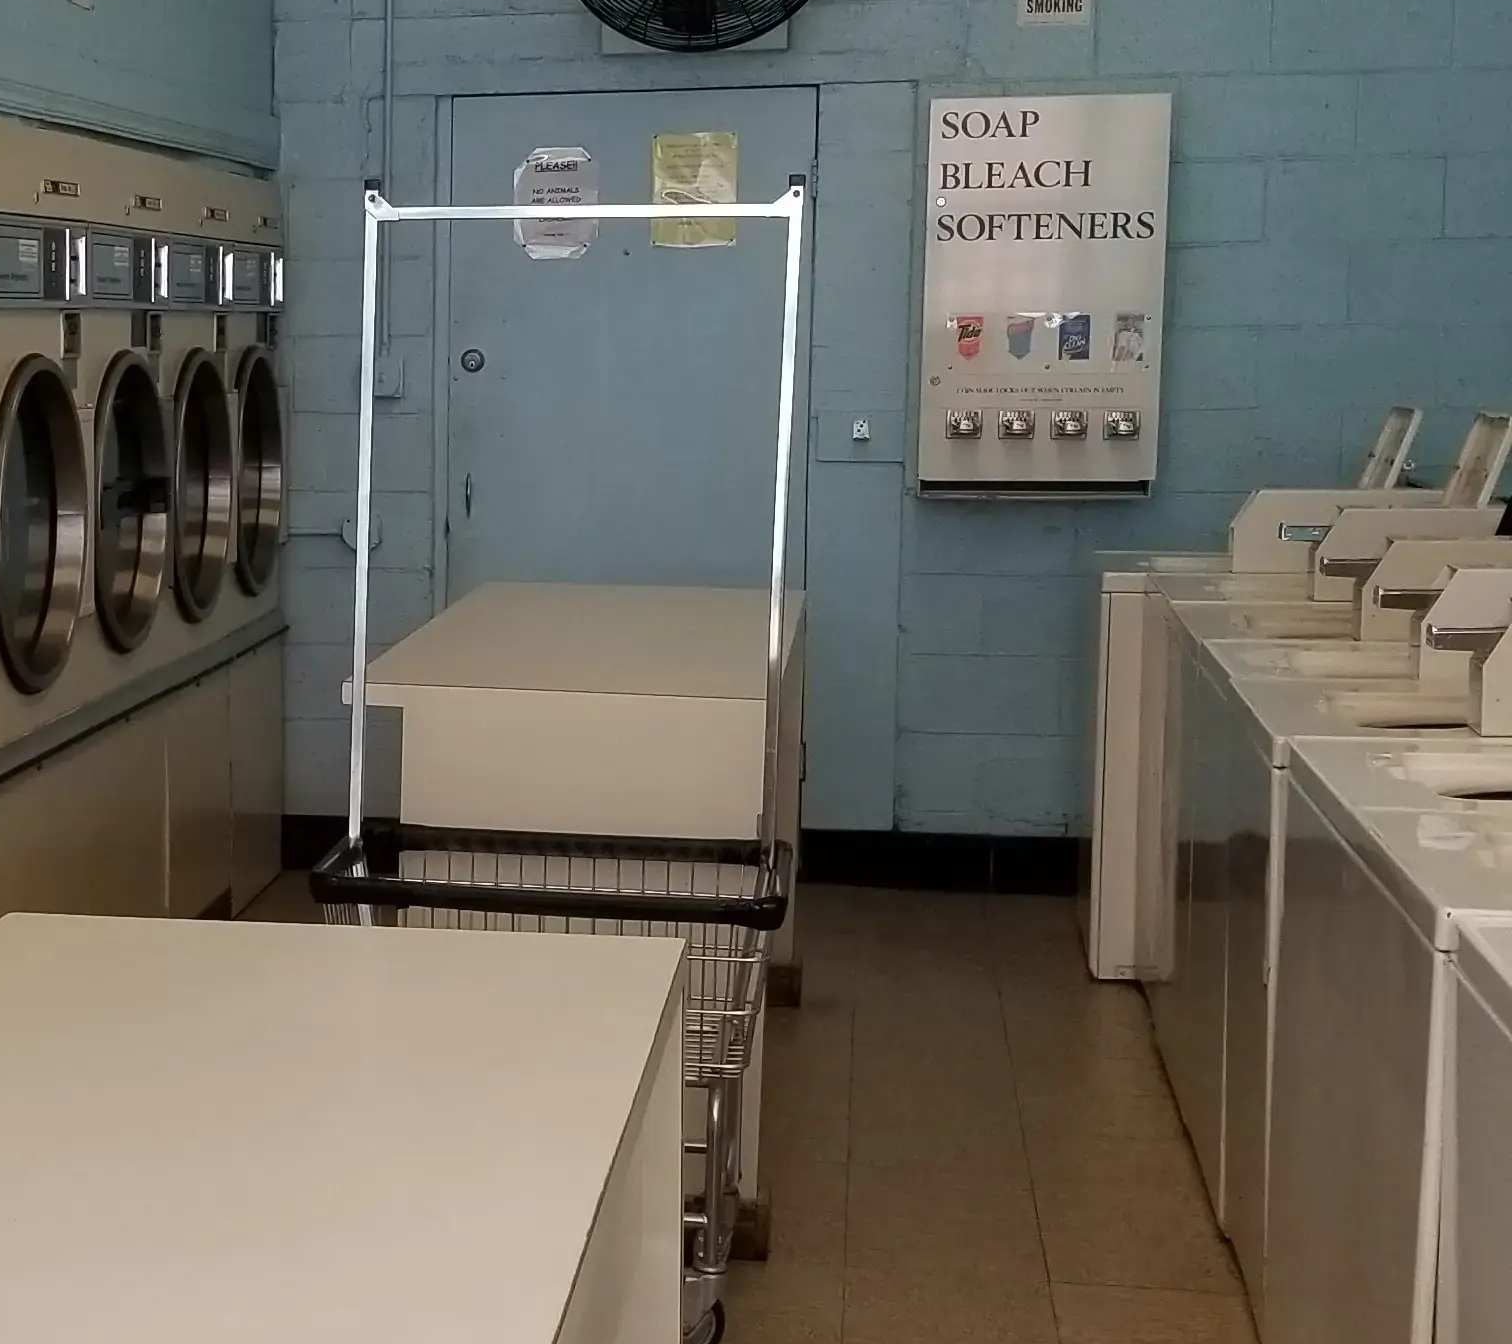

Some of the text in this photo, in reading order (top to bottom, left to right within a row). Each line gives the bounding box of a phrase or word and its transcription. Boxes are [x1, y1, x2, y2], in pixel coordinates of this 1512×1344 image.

[941, 110, 1040, 140] SOAP
[938, 159, 1093, 190] BLEACH
[531, 196, 582, 205] ARE ALLOWED
[936, 211, 1156, 242] SOFTENERS
[958, 324, 981, 342] Tide
